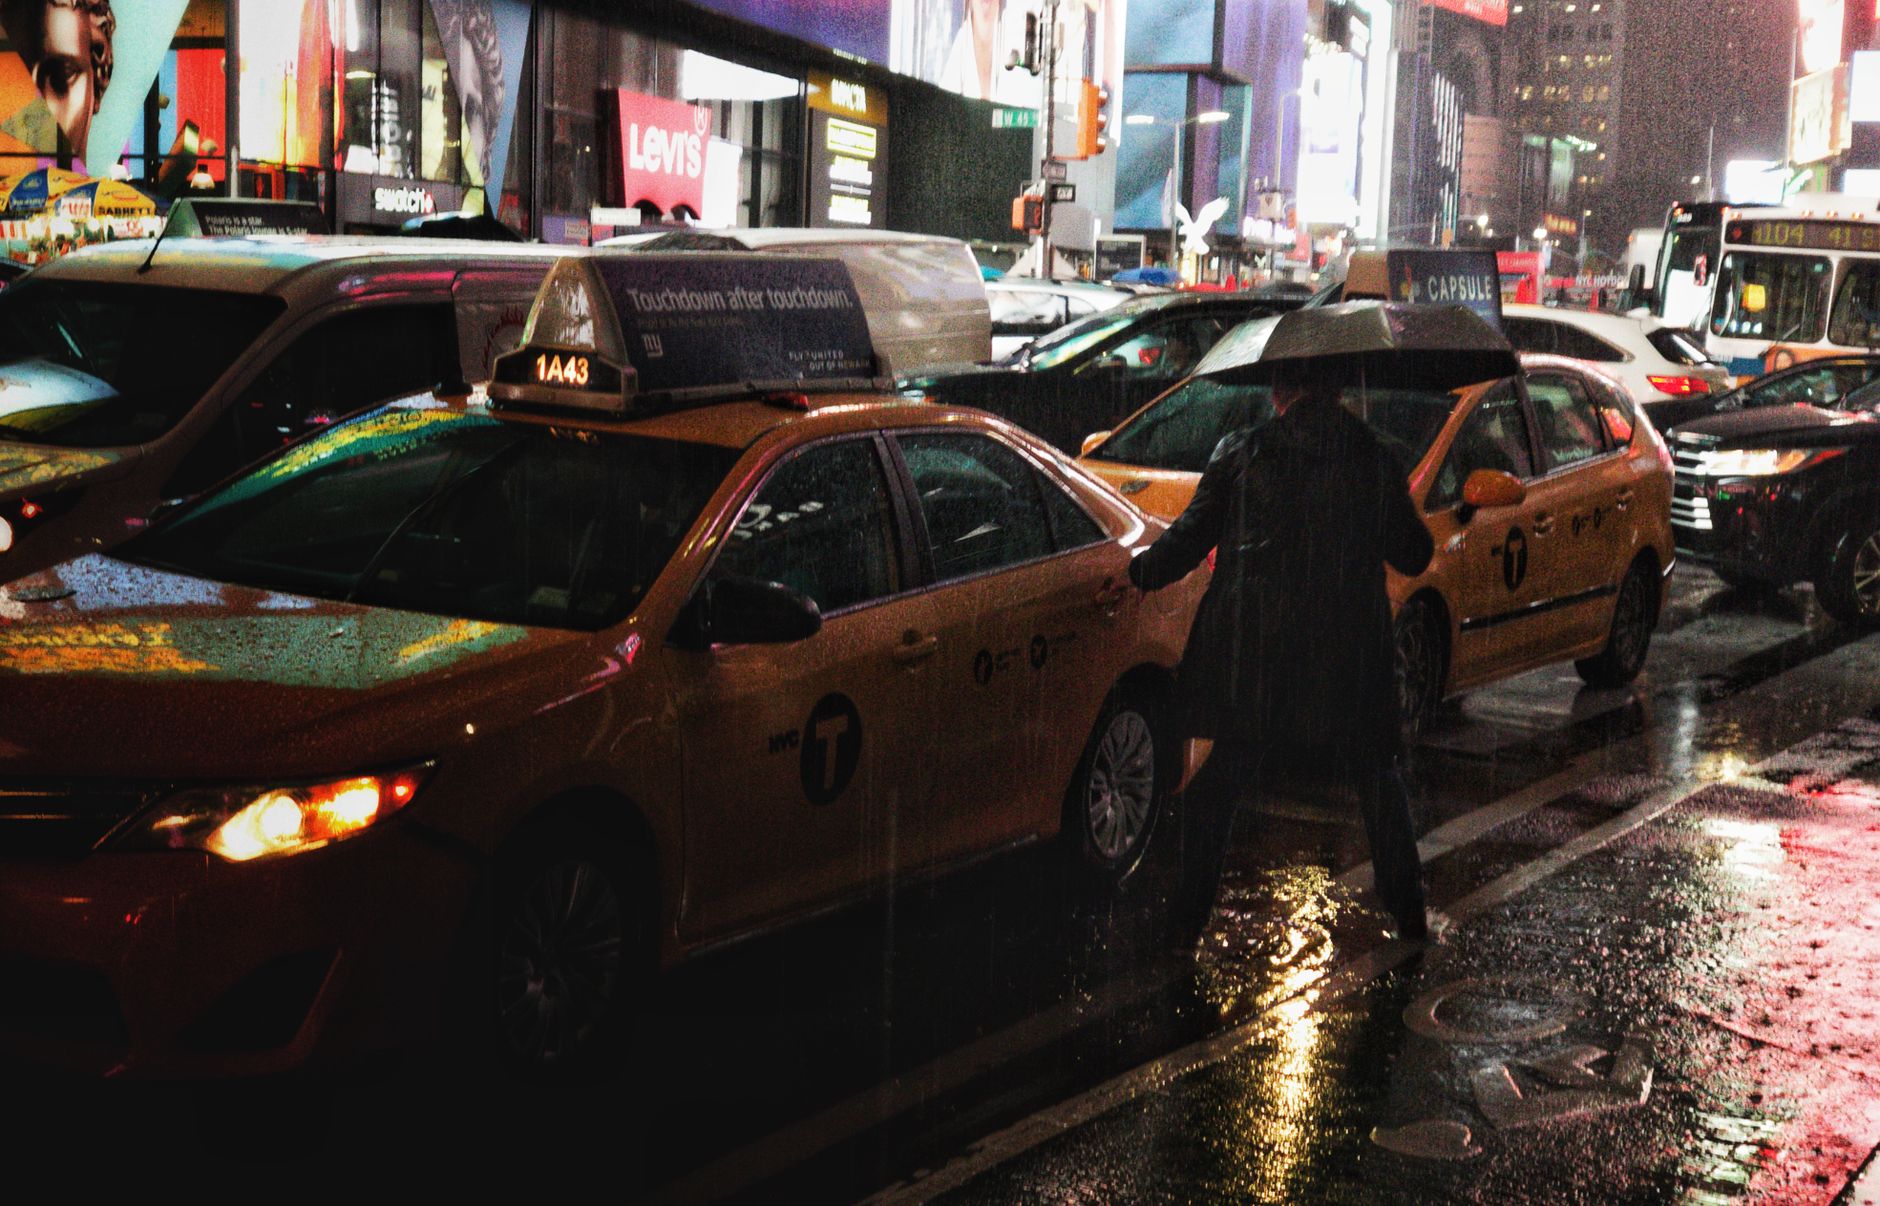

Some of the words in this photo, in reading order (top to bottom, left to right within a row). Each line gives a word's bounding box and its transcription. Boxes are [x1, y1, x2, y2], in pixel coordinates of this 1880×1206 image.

[375, 187, 426, 213] swatch
[626, 286, 727, 313] Touchdown
[727, 285, 765, 311] after
[766, 285, 854, 311] touchdown.
[1428, 275, 1492, 301] CAPSULE
[536, 353, 589, 385] 1A43
[768, 729, 799, 754] NYC
